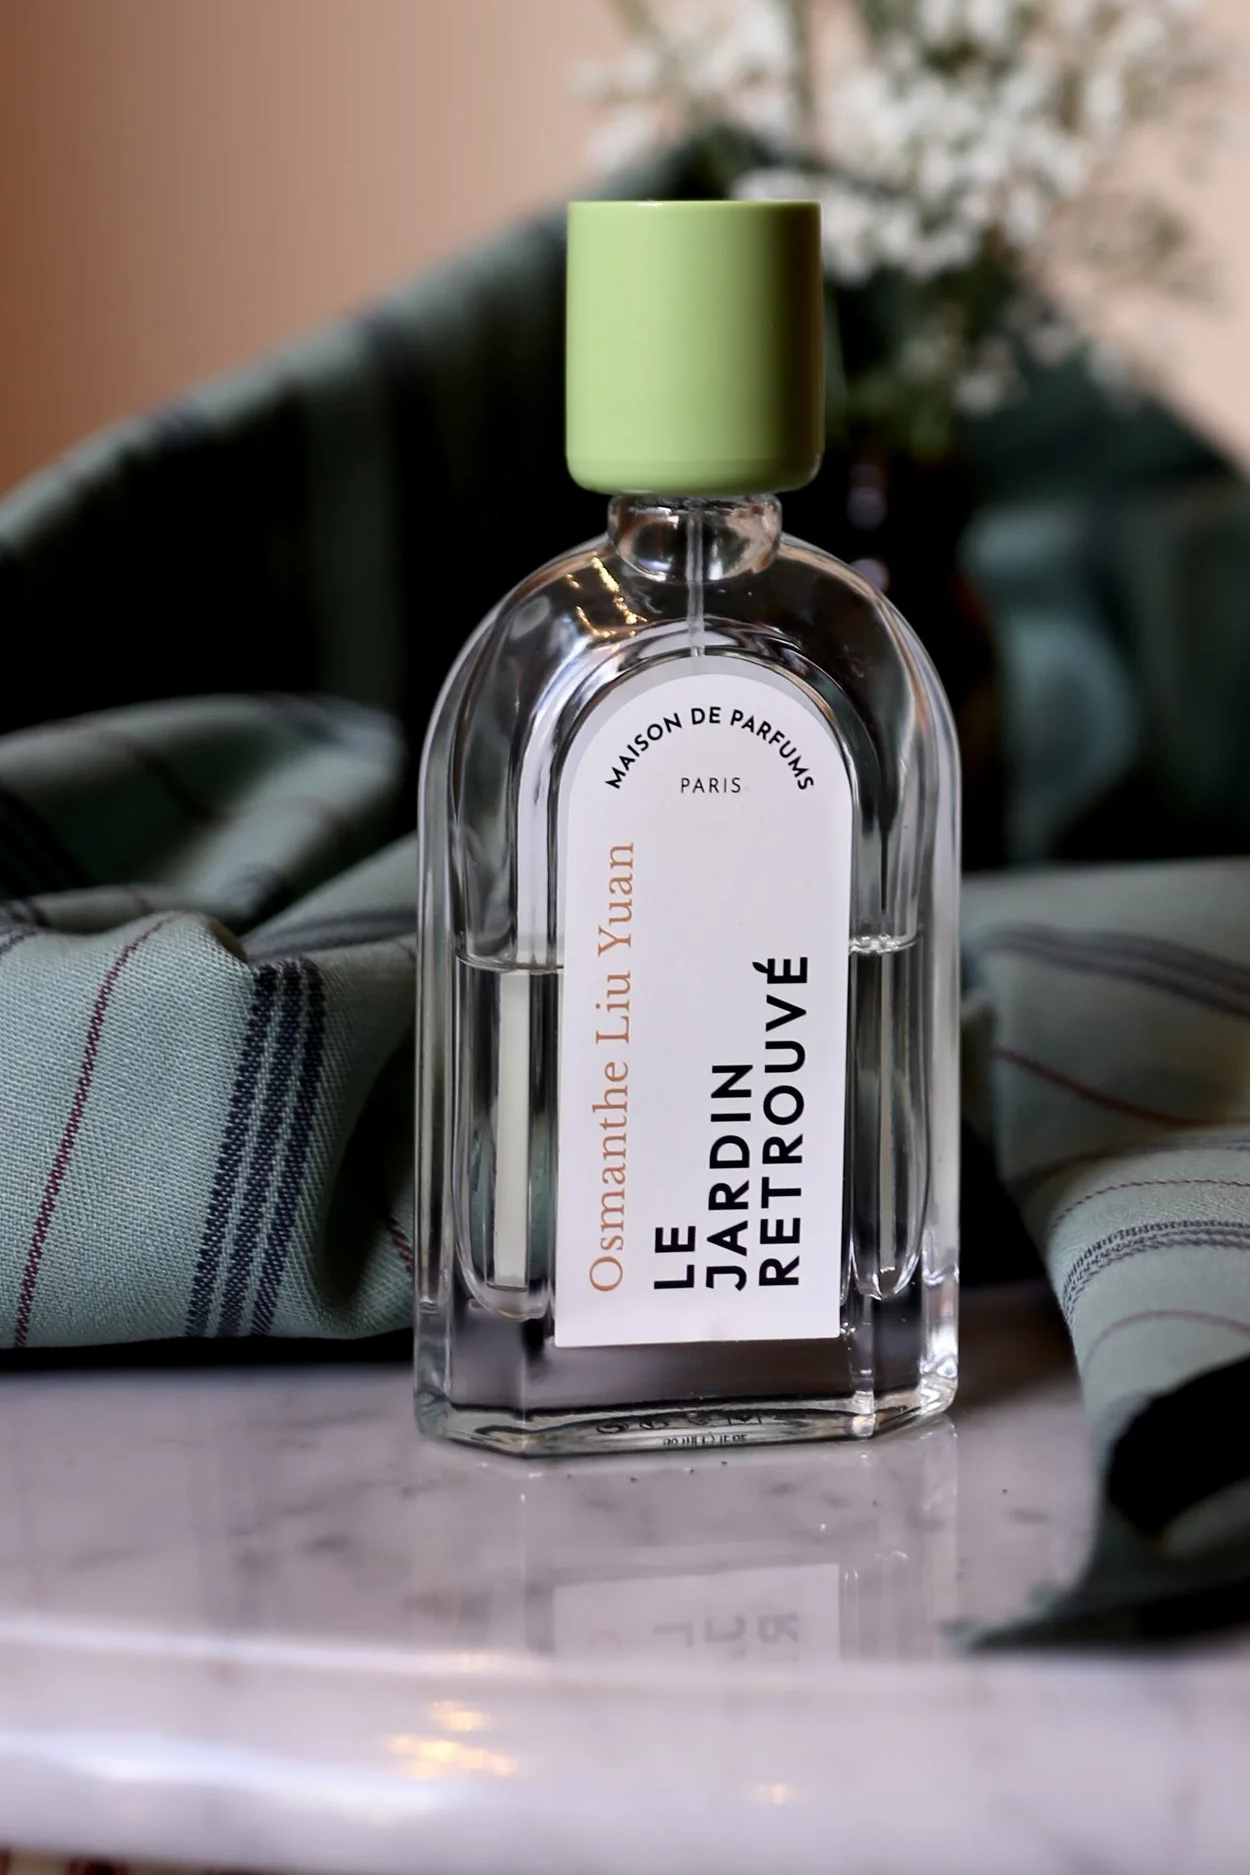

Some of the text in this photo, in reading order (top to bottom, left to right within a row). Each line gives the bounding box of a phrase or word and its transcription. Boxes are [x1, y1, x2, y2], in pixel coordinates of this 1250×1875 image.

[604, 705, 815, 791] MAISON DE PARFUMS
[680, 776, 742, 794] PARIS
[589, 843, 634, 1292] Osmanthe Liu Yuan
[751, 956, 809, 1287] RETROUVÉ
[705, 1064, 754, 1292] JARDIN
[653, 1225, 697, 1291] LE
